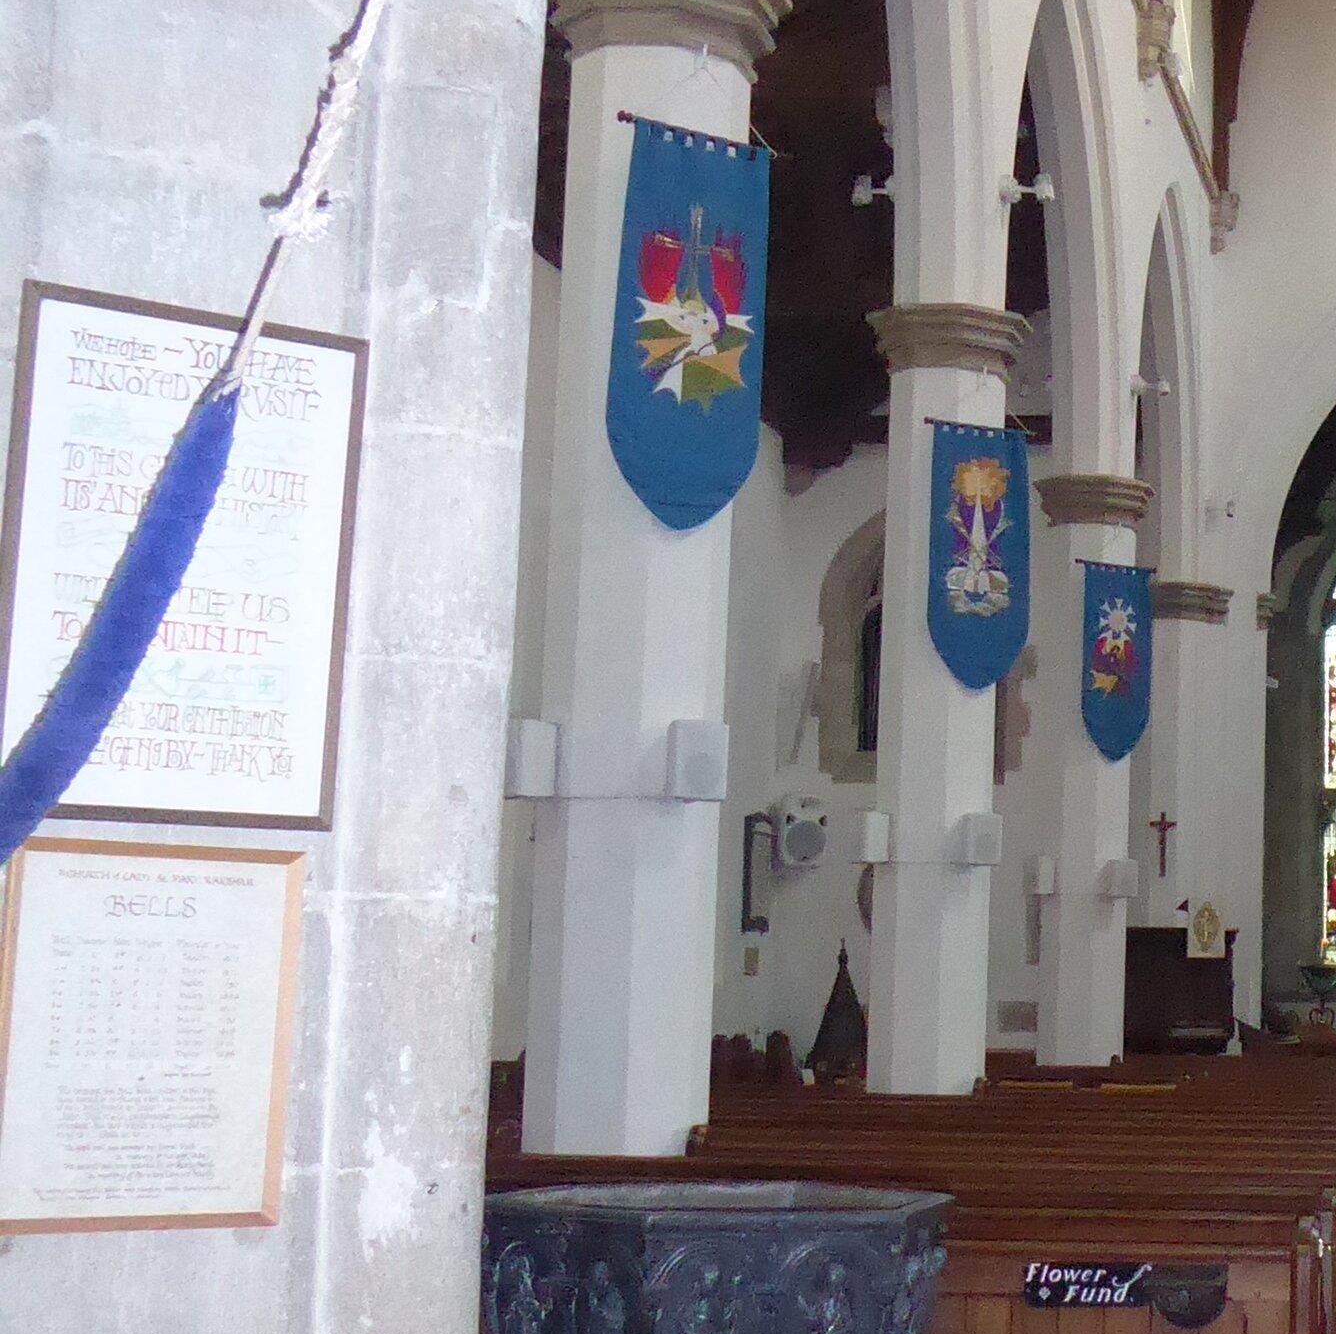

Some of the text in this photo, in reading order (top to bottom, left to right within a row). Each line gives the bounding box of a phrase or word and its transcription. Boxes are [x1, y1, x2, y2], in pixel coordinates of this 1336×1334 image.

[86, 445, 134, 478] THIS
[241, 467, 310, 504] WITH
[240, 592, 290, 624] US
[103, 893, 197, 919] BELLS
[1026, 1263, 1107, 1283] Flower
